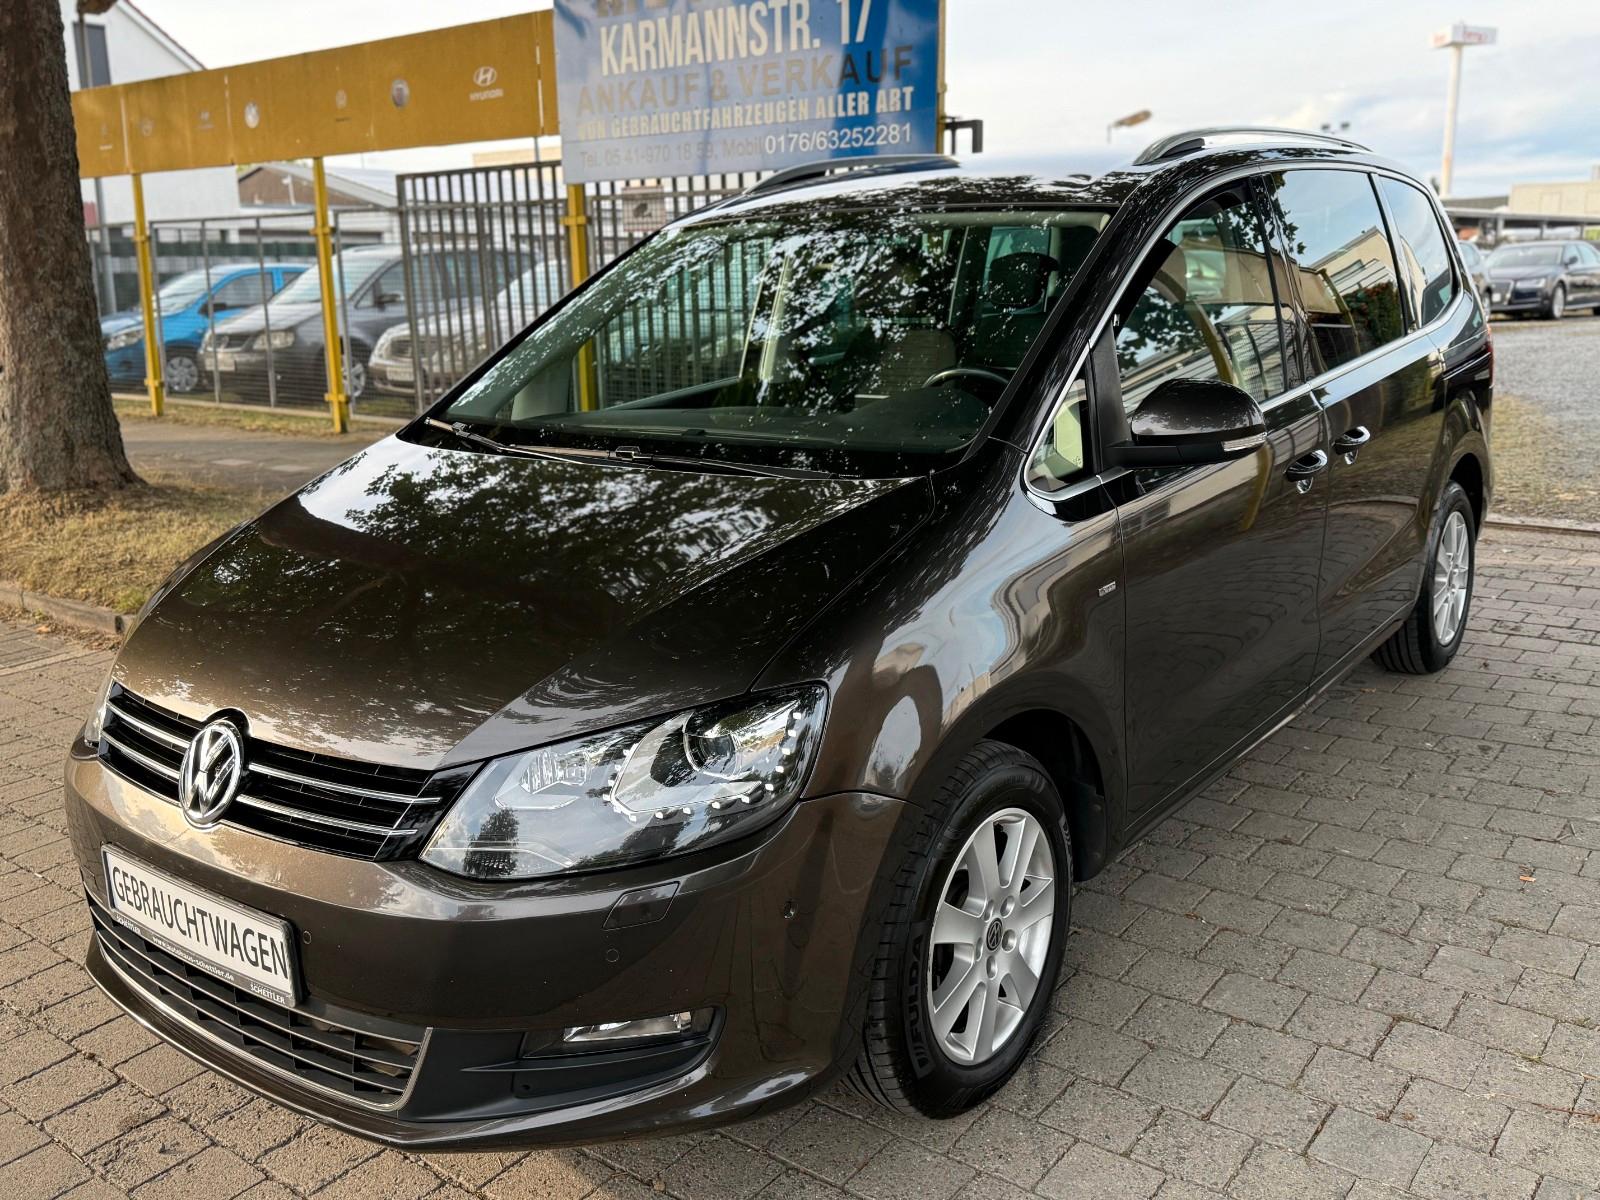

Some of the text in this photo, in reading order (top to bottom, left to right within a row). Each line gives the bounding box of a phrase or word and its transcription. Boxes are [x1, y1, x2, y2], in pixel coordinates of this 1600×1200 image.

[600, 0, 821, 77] KARMANNSTR.
[577, 45, 914, 118] ANKAUF & VERKAUF
[611, 99, 809, 138] GEBRAUCHTFAHRZEUGEN
[816, 91, 870, 119] ALLER
[876, 86, 915, 113] ART
[765, 123, 912, 154] 0176/63252281
[112, 866, 290, 980] GEBRAUCHTWAGEN
[250, 983, 286, 1005] SCHETTLER
